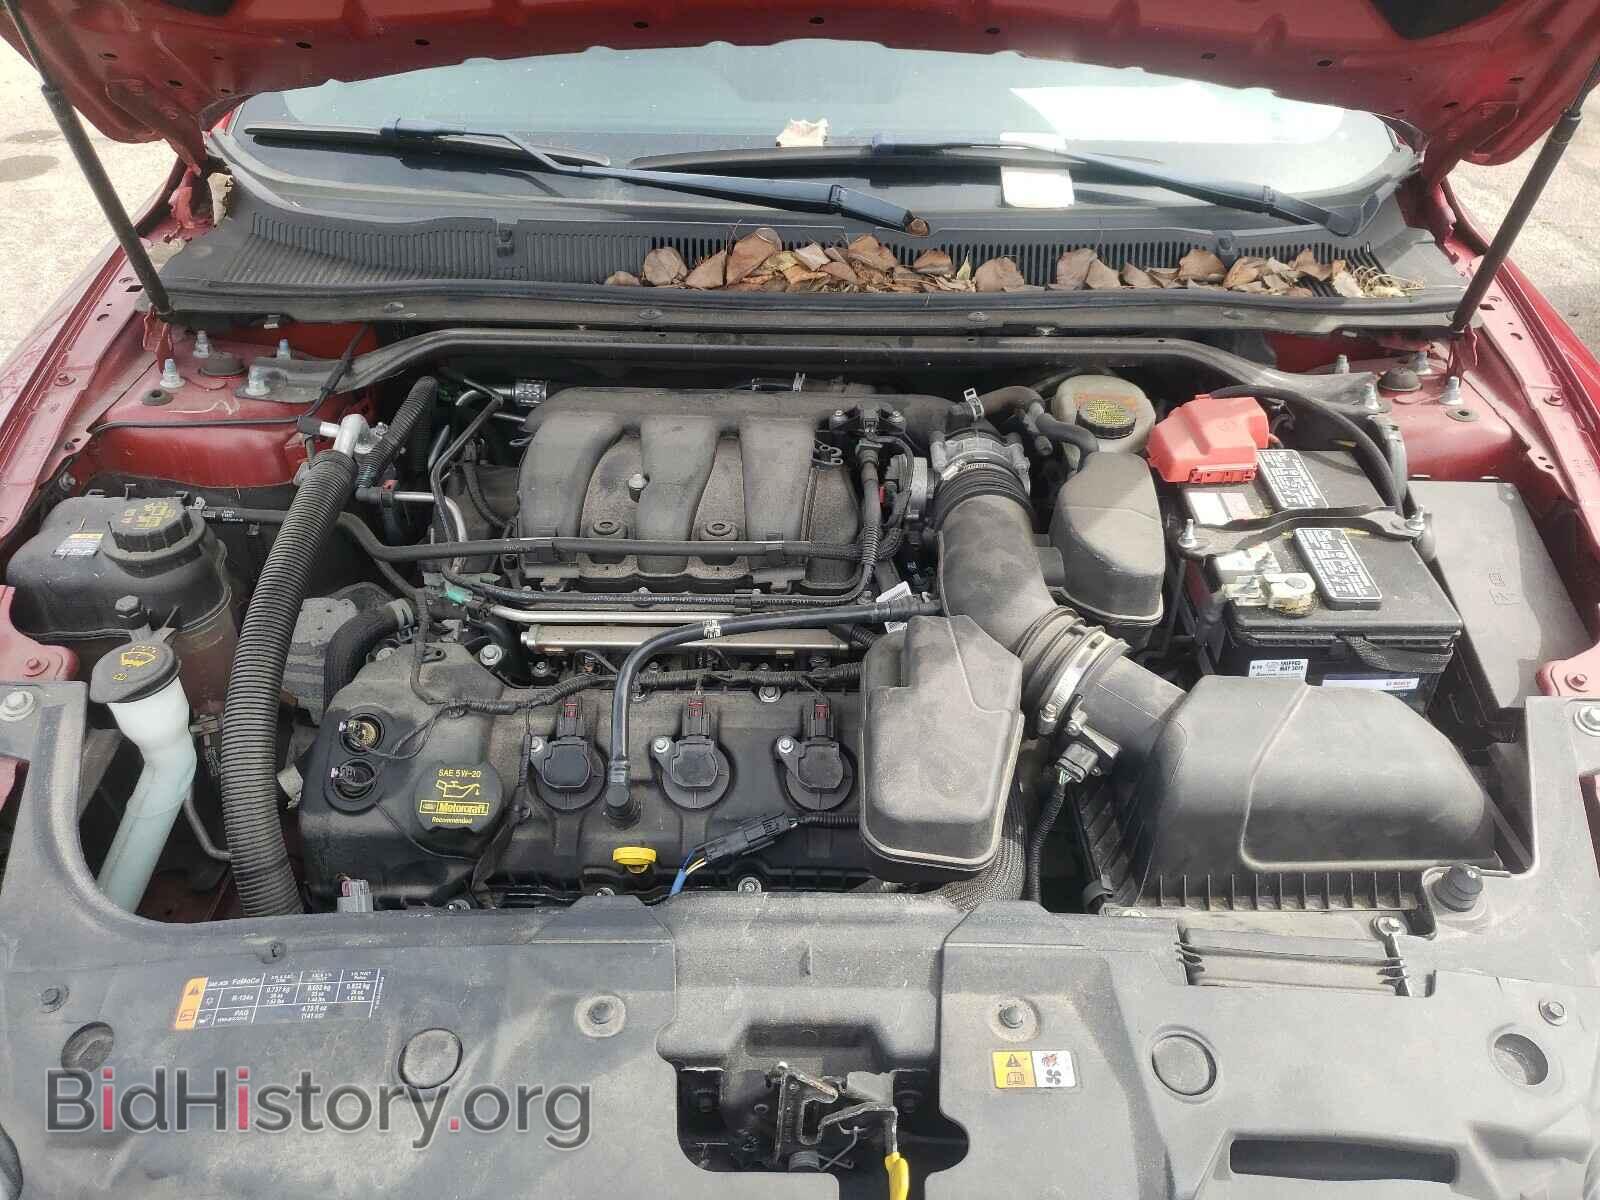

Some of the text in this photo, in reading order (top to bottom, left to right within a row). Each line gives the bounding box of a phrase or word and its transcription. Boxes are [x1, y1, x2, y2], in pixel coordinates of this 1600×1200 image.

[438, 768, 481, 778] SAE 5W-20
[439, 802, 486, 815] Motorcraft
[431, 816, 473, 824] Recommended
[232, 977, 260, 985] FoMoCo
